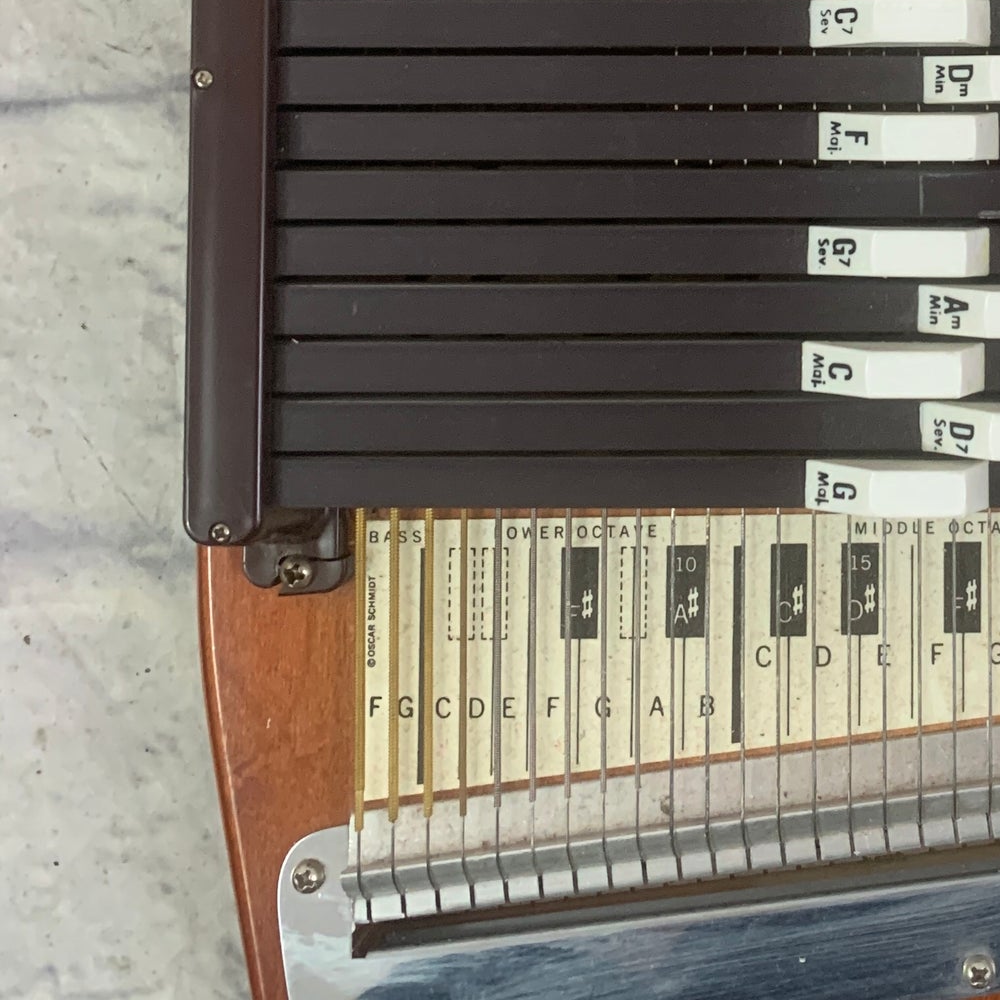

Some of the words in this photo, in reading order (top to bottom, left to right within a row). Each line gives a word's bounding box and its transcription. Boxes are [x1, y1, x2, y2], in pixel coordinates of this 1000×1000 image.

[820, 9, 832, 35] Sev
[835, 7, 858, 35] C7
[935, 65, 945, 94] Min
[948, 64, 974, 97] Dm
[827, 121, 842, 155] Maj.
[845, 130, 869, 146] F
[832, 238, 857, 268] G7
[929, 294, 941, 325] Min
[943, 295, 969, 330] Am
[828, 362, 853, 381] C
[933, 418, 947, 451] Sev.
[949, 421, 975, 454] D7
[833, 482, 857, 500] G
[369, 530, 422, 544] BASS
[494, 525, 564, 540] OWER
[855, 521, 935, 535] MIDDLE
[674, 556, 698, 572] 10
[850, 554, 872, 571] 15
[367, 576, 376, 621] SCHMIDT
[755, 644, 772, 668] C
[815, 644, 832, 667] D
[878, 643, 891, 667] E
[931, 642, 944, 666] F
[369, 696, 382, 718] F
[398, 695, 414, 719] G
[436, 696, 451, 719] C
[469, 697, 484, 718] D
[502, 697, 516, 719] E
[547, 696, 560, 718] F
[595, 696, 611, 719] G
[649, 695, 664, 717] A
[698, 695, 715, 717] B
